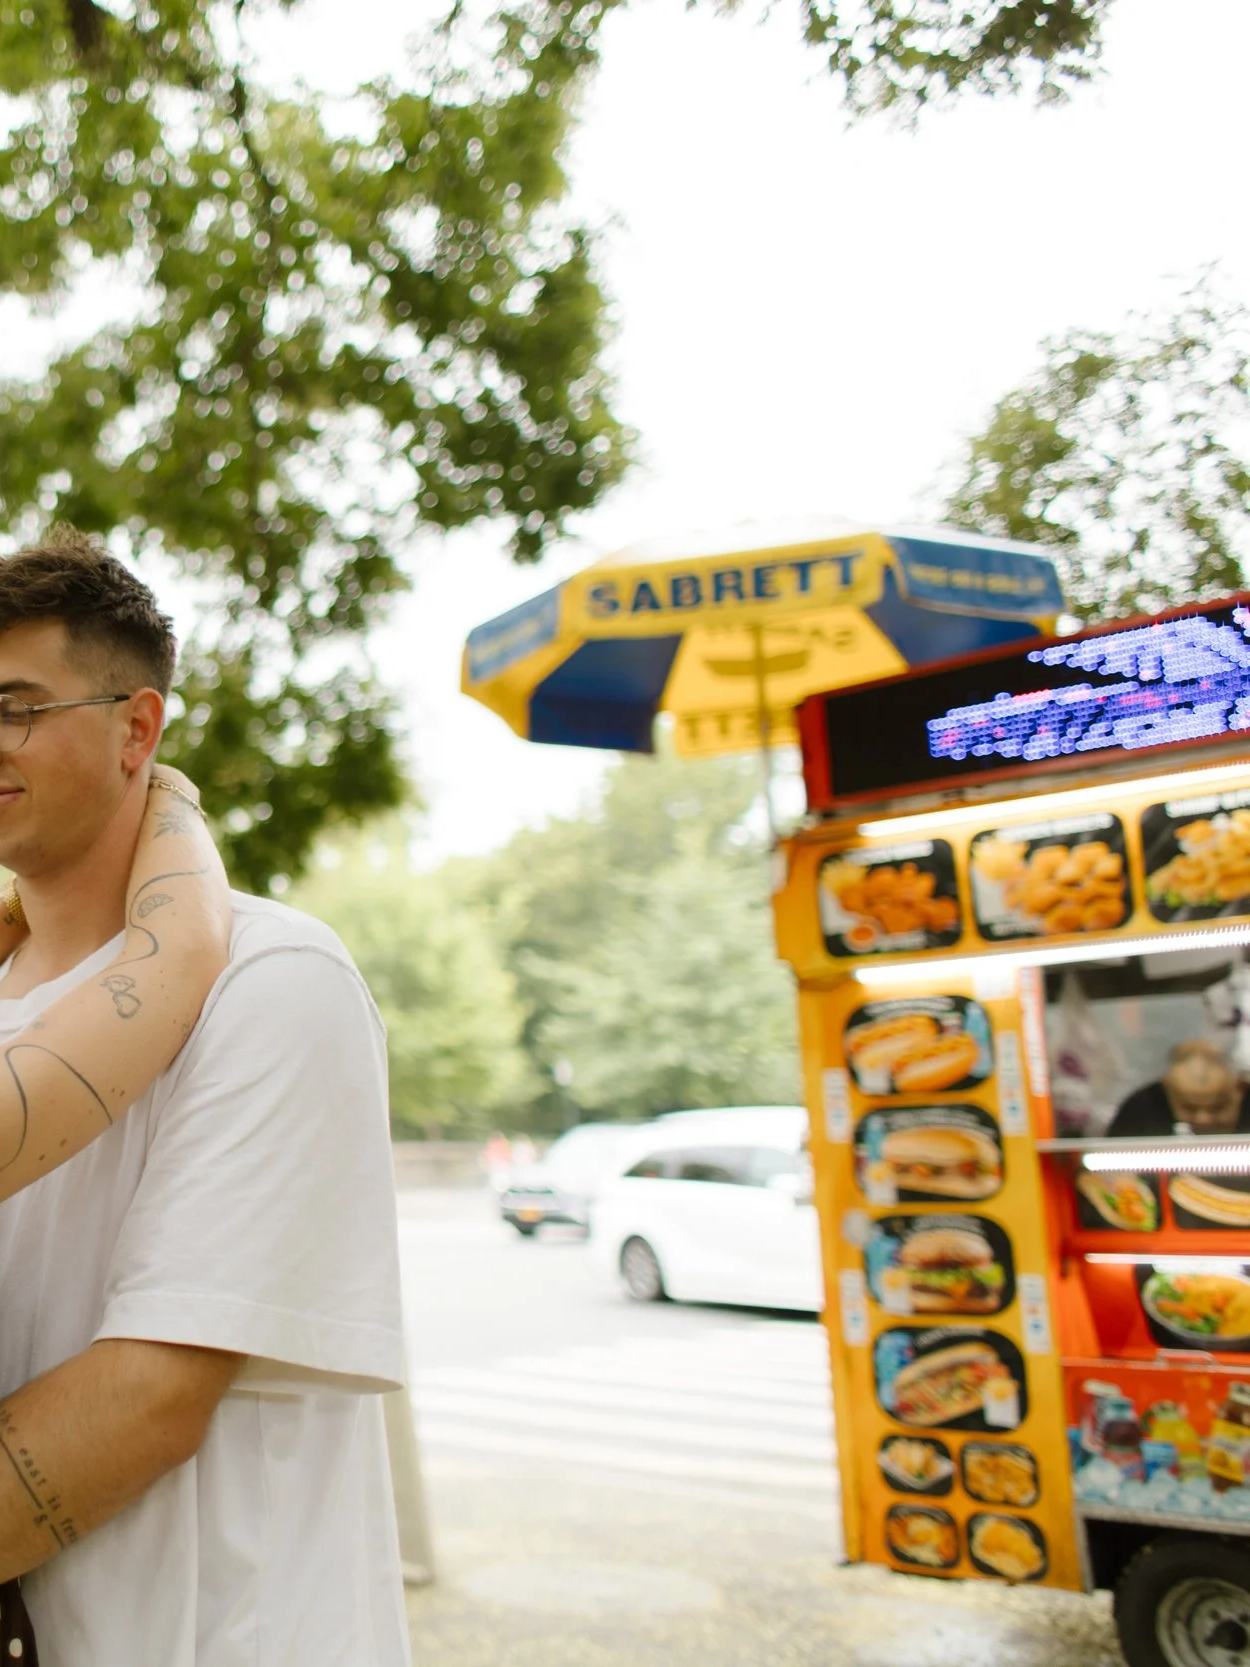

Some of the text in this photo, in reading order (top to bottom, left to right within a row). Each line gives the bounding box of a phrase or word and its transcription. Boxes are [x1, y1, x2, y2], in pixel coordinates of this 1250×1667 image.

[588, 549, 864, 619] SABRETT
[19, 1447, 47, 1486] east
[47, 1494, 62, 1512] is
